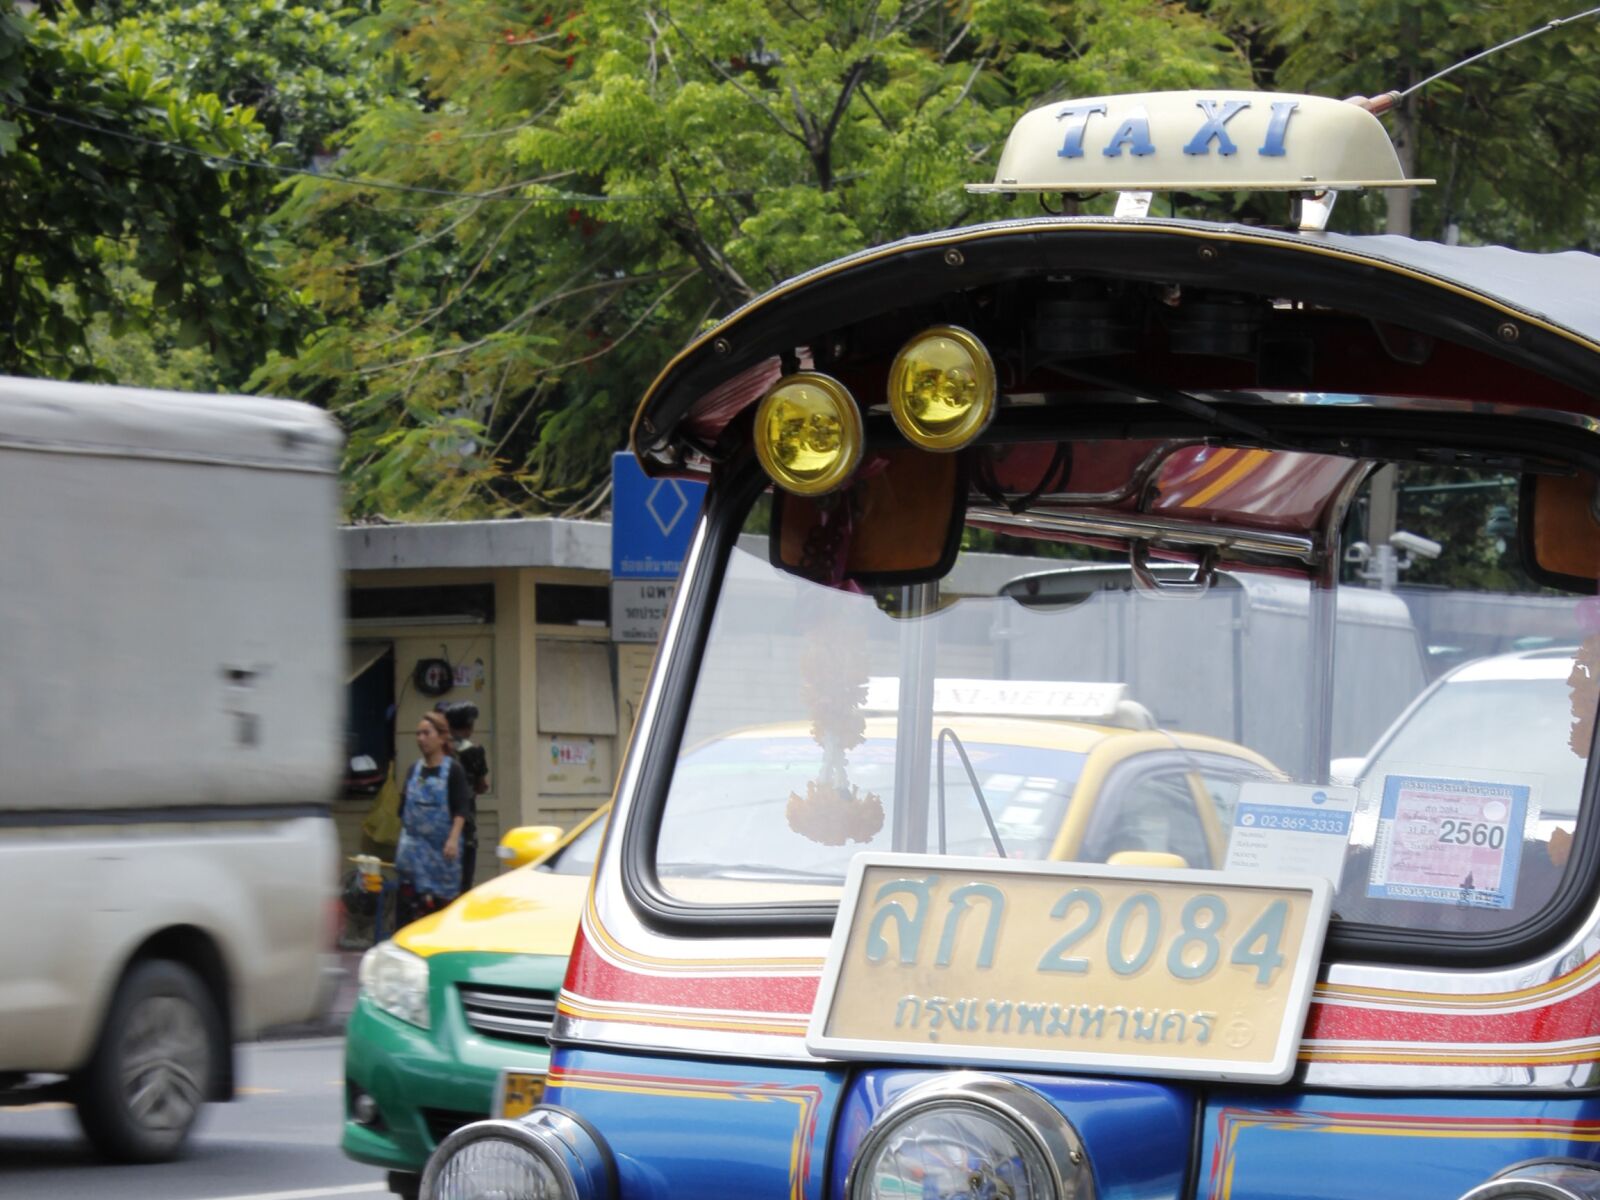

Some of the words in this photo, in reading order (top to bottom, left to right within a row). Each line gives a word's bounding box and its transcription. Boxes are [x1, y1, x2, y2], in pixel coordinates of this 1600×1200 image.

[1056, 100, 1299, 159] TAXI
[641, 586, 675, 599] เฉพา
[934, 688, 1105, 708] XI-METER
[1260, 815, 1344, 834] 02-869-3333
[1439, 820, 1505, 850] 2560
[865, 876, 1006, 969] สก
[1037, 887, 1293, 987] 2084
[893, 994, 1220, 1047] กรุงเทพมหานคร
